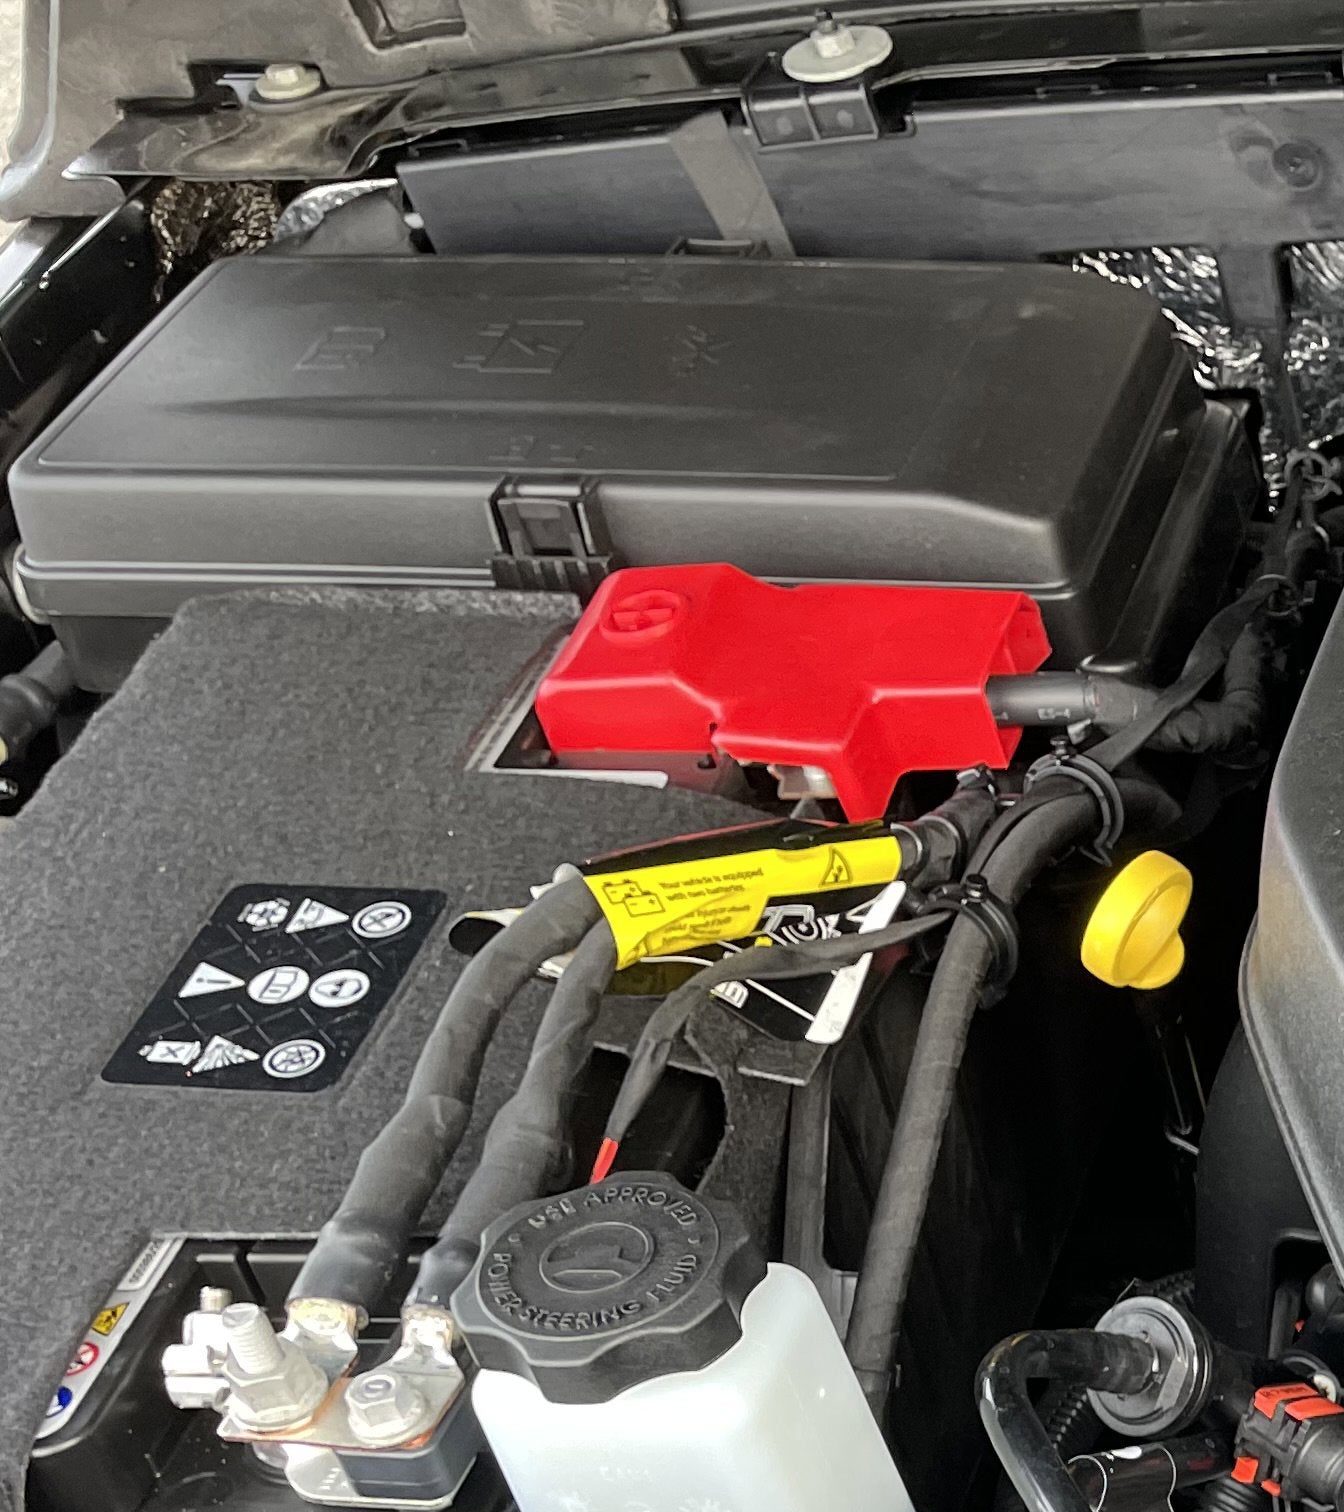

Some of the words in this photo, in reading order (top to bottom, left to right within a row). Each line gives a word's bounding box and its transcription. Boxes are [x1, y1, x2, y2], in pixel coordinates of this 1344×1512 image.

[528, 1198, 577, 1229] USE
[583, 1186, 698, 1227] APPROVED
[518, 1299, 642, 1331] STEERING
[646, 1253, 698, 1302] FLUID
